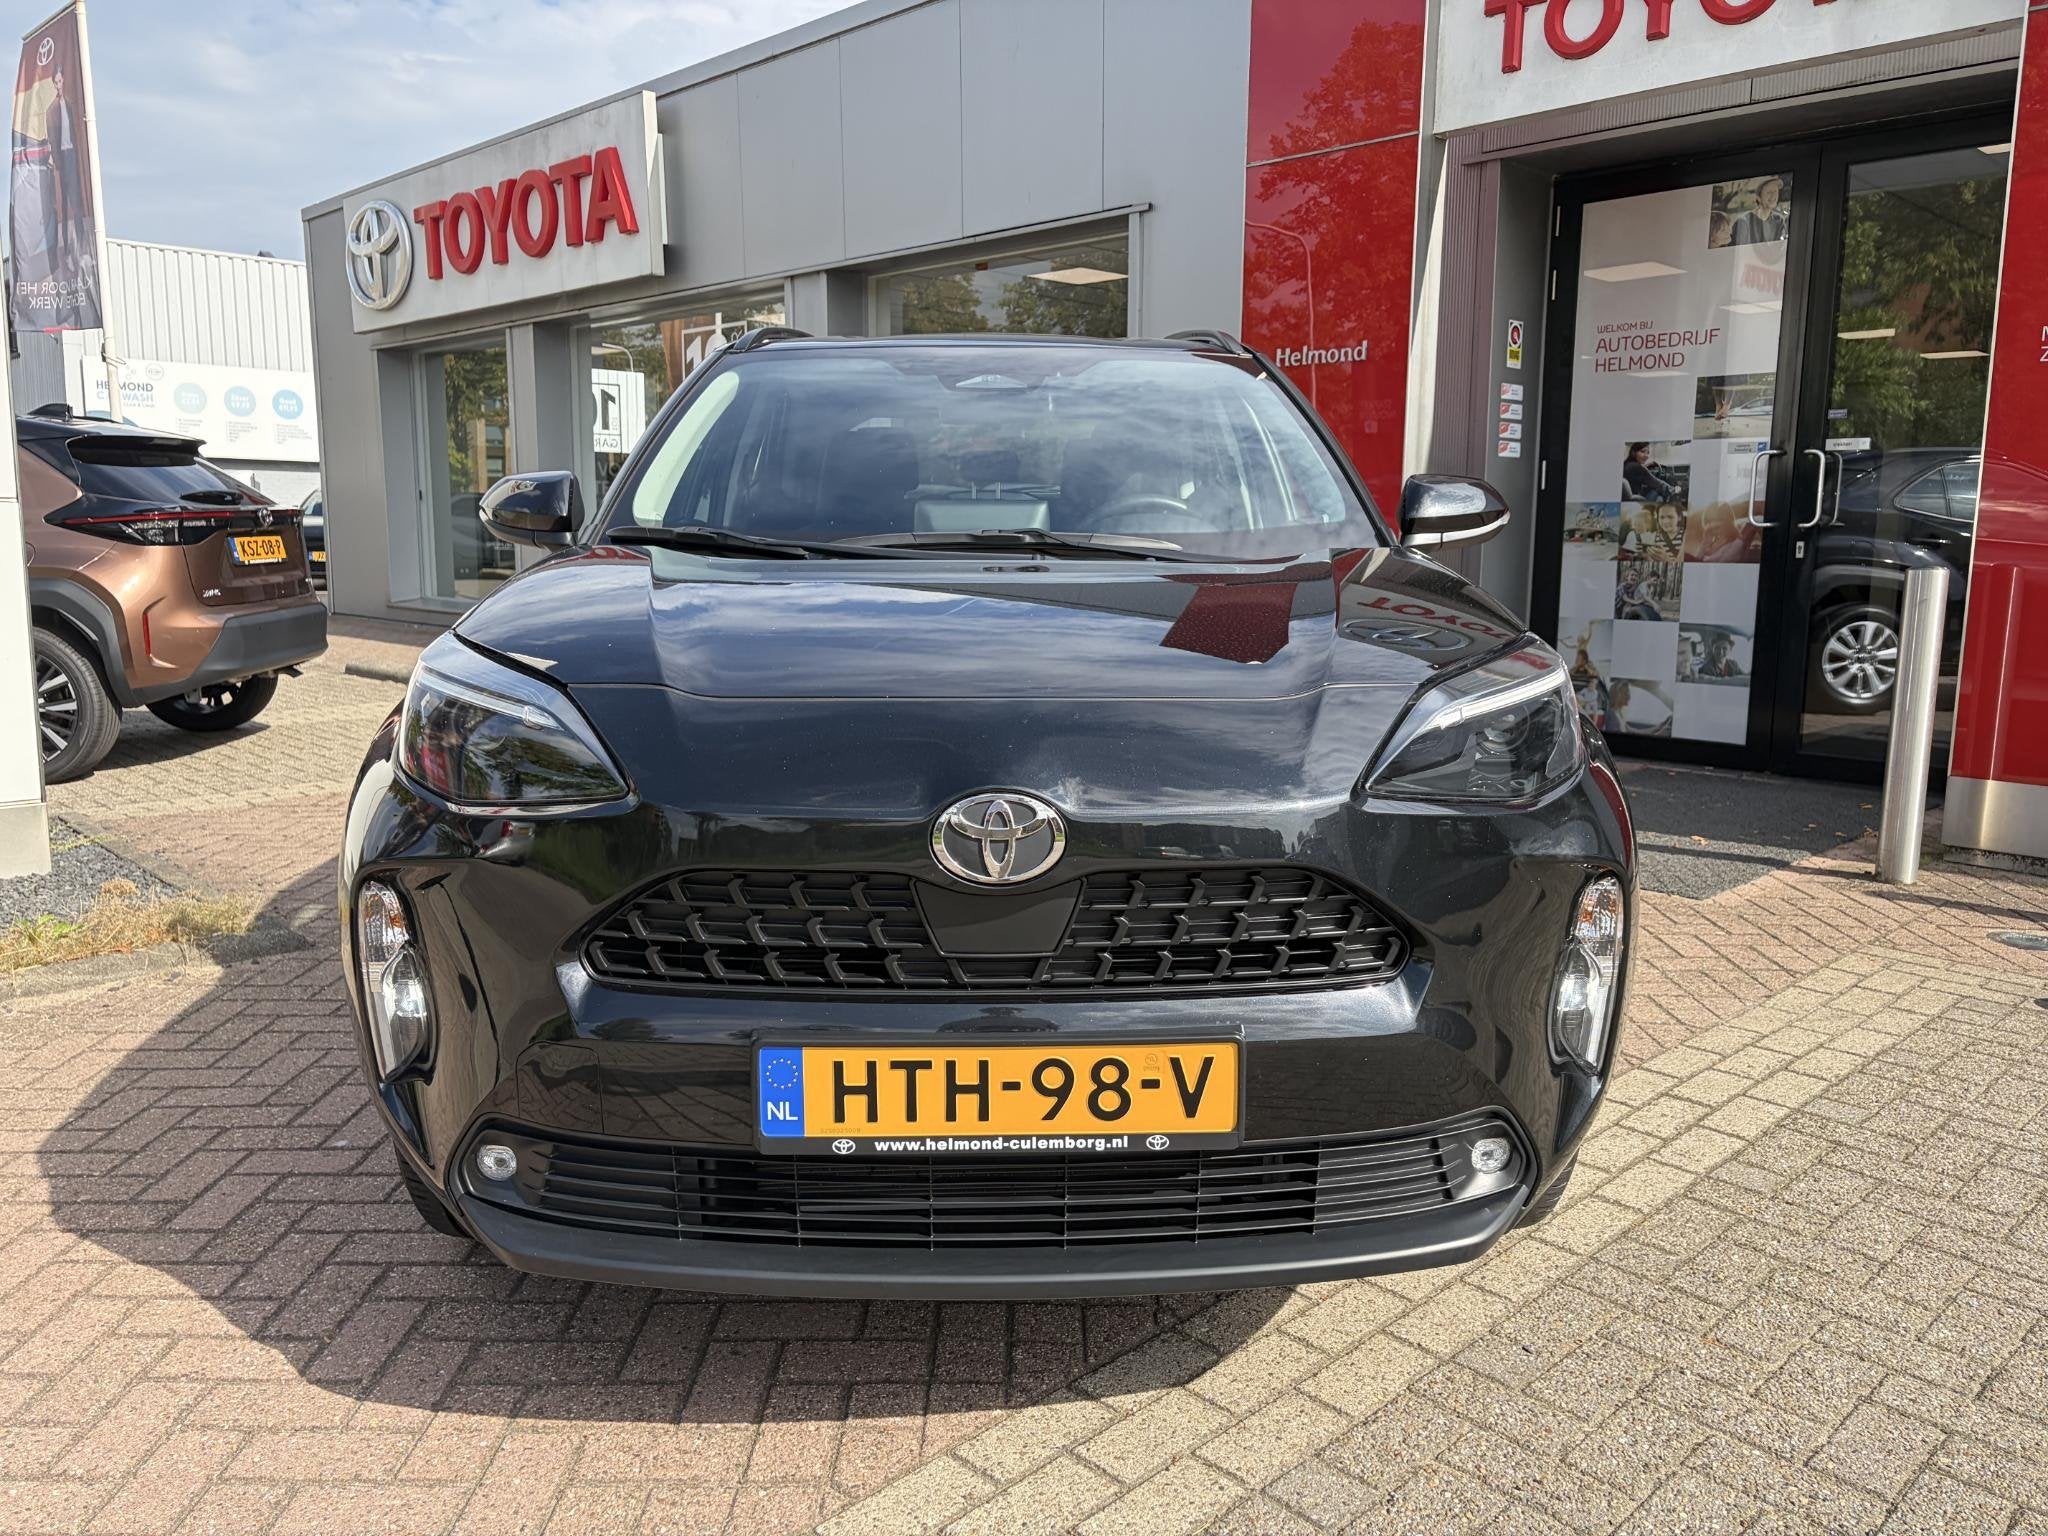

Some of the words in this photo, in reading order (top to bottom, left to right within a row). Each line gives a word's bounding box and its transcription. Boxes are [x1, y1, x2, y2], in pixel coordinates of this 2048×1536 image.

[413, 145, 639, 280] TOYOTA
[1597, 322, 1638, 334] WELKOM
[1595, 328, 1721, 353] AUTOBEDRIJF
[1275, 339, 1368, 367] Helmond
[1595, 352, 1685, 373] HELMOND
[96, 379, 154, 392] HEMOND
[240, 540, 282, 557] KSZ-08-P
[833, 1056, 1215, 1123] HTH-98-V
[767, 1100, 799, 1121] NL
[874, 1135, 1129, 1153] www.helmond-culemborg.nl
